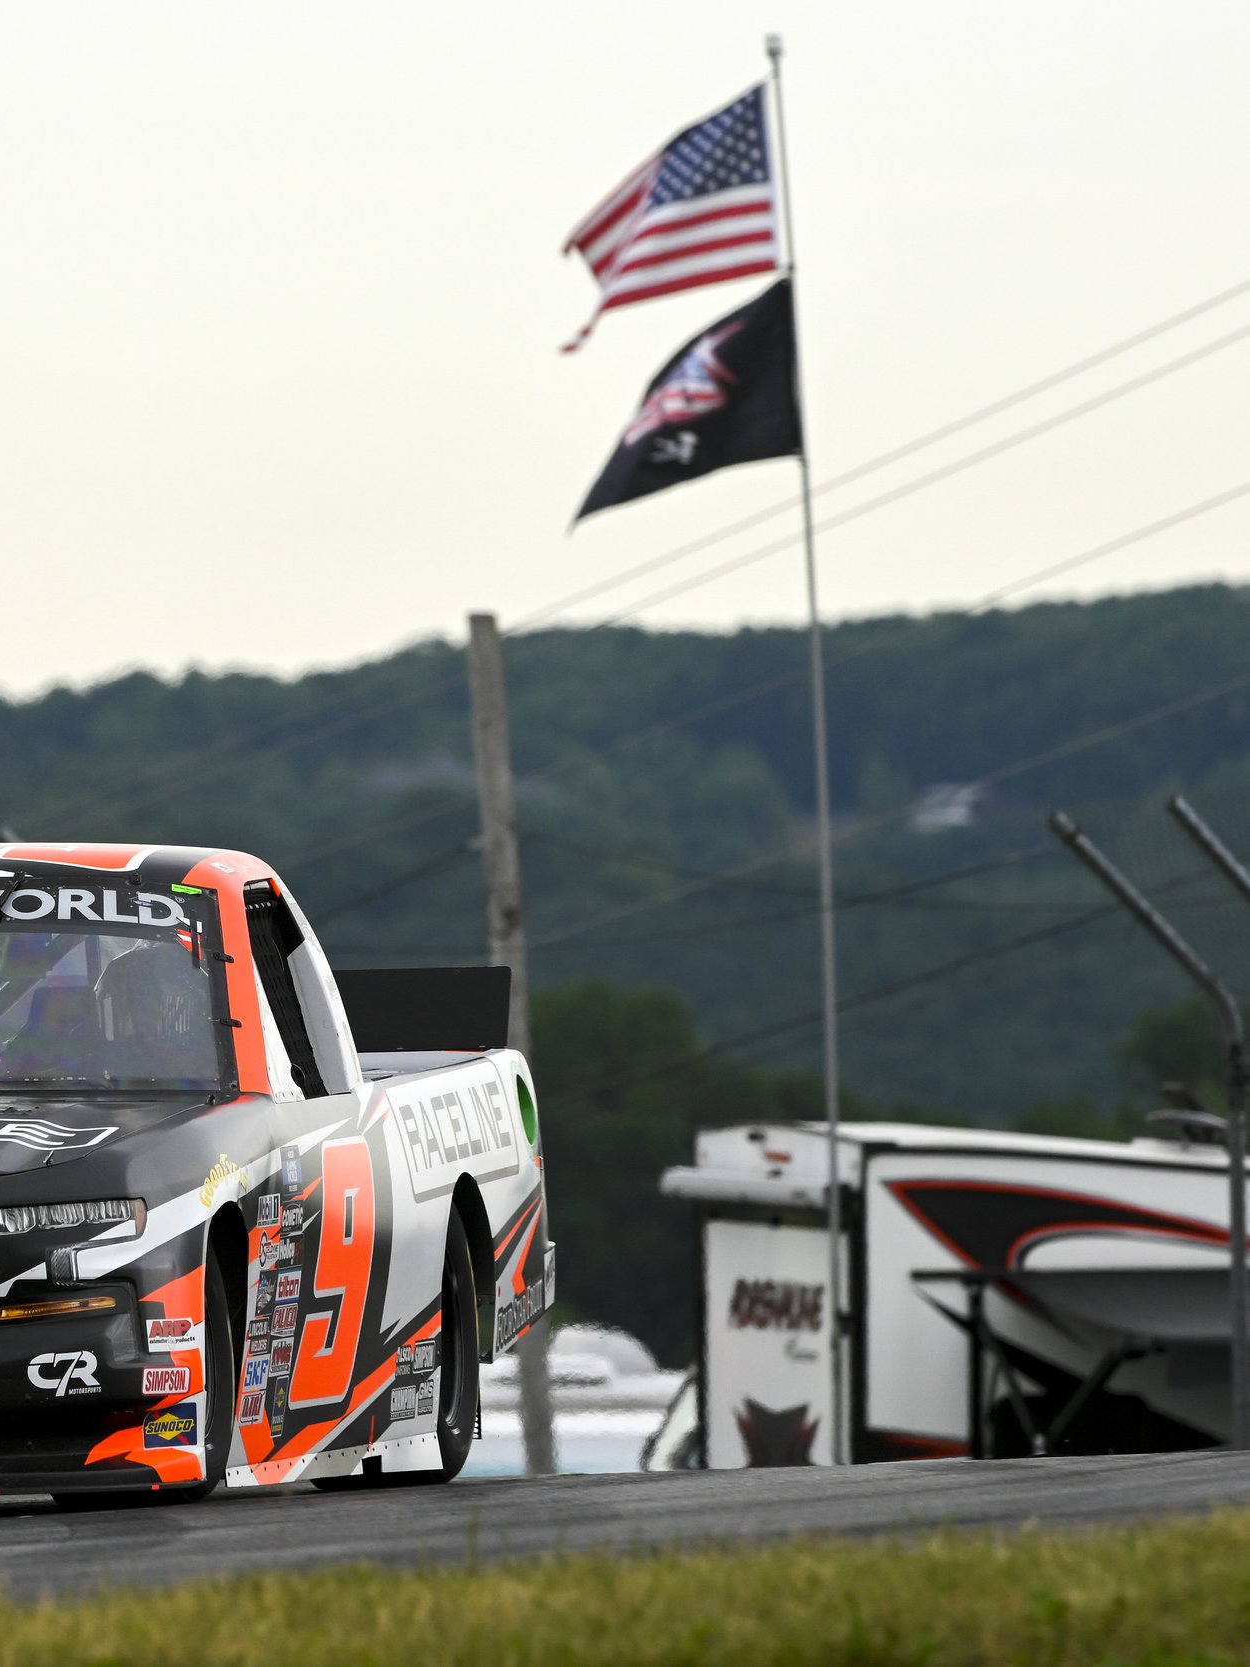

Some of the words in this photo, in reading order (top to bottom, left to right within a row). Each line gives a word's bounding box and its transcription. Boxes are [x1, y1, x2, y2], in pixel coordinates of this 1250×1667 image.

[398, 1080, 512, 1173] RACELINE
[288, 1135, 375, 1410] 9
[149, 1319, 192, 1338] ARP
[145, 1369, 186, 1392] SIMPSON
[244, 1359, 269, 1387] SKF
[146, 1420, 193, 1434] SUNOCO
